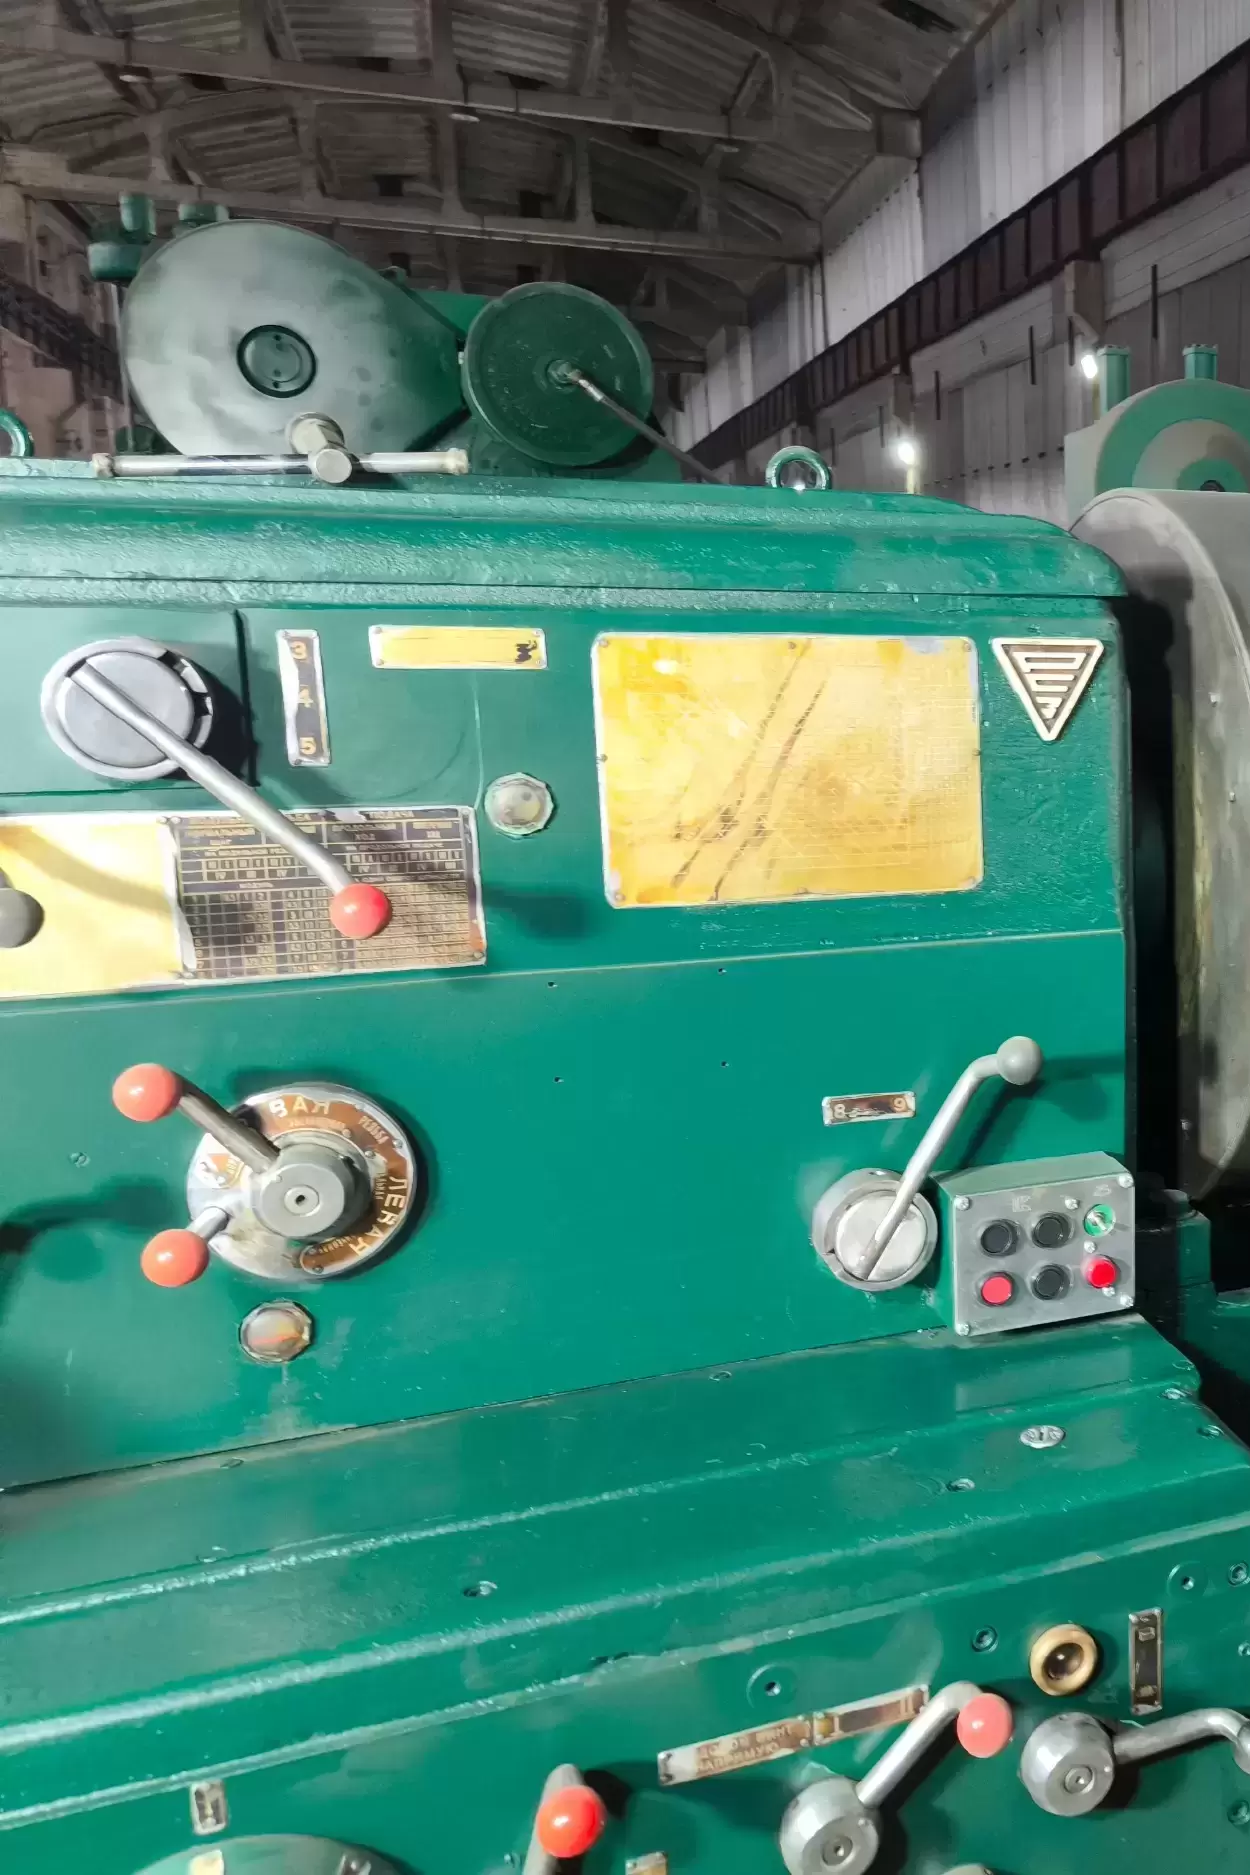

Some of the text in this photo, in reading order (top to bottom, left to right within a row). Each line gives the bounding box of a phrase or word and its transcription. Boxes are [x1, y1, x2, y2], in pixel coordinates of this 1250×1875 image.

[290, 640, 307, 660] 3
[298, 686, 314, 708] 4
[299, 736, 317, 756] 5
